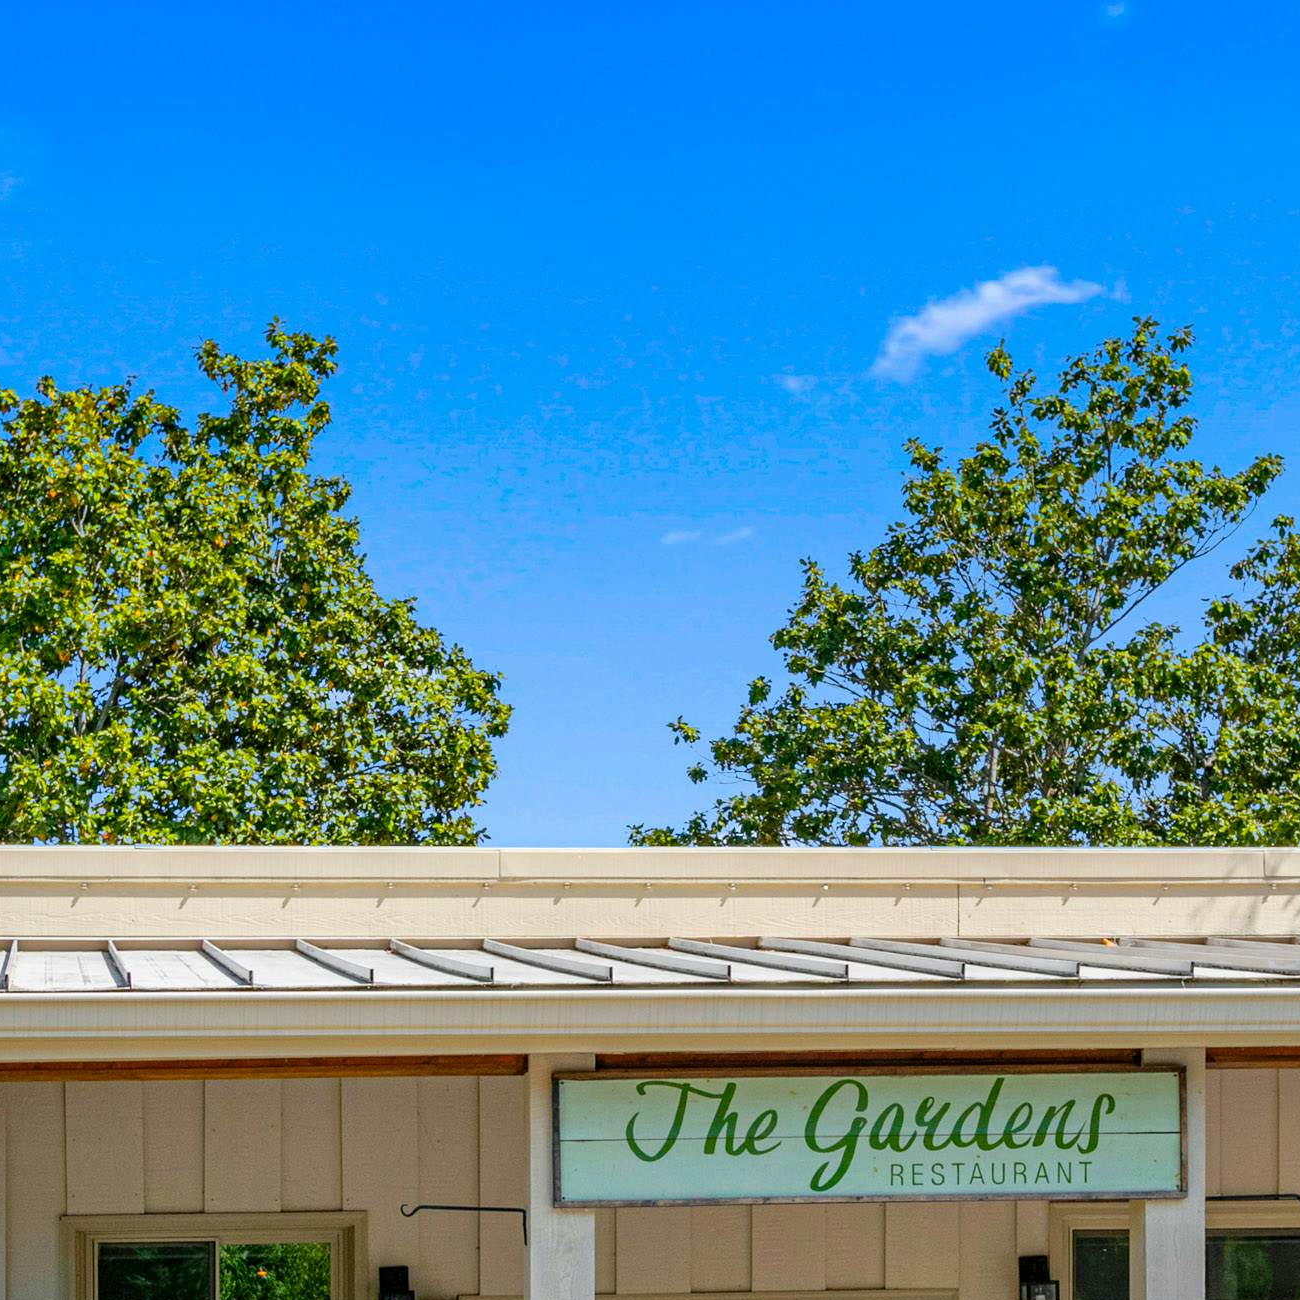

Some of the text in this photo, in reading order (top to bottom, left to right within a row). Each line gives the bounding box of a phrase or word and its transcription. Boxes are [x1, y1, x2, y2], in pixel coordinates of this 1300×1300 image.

[625, 1077, 1116, 1192] The Gardens
[890, 1161, 1094, 1187] RESTAURANT
